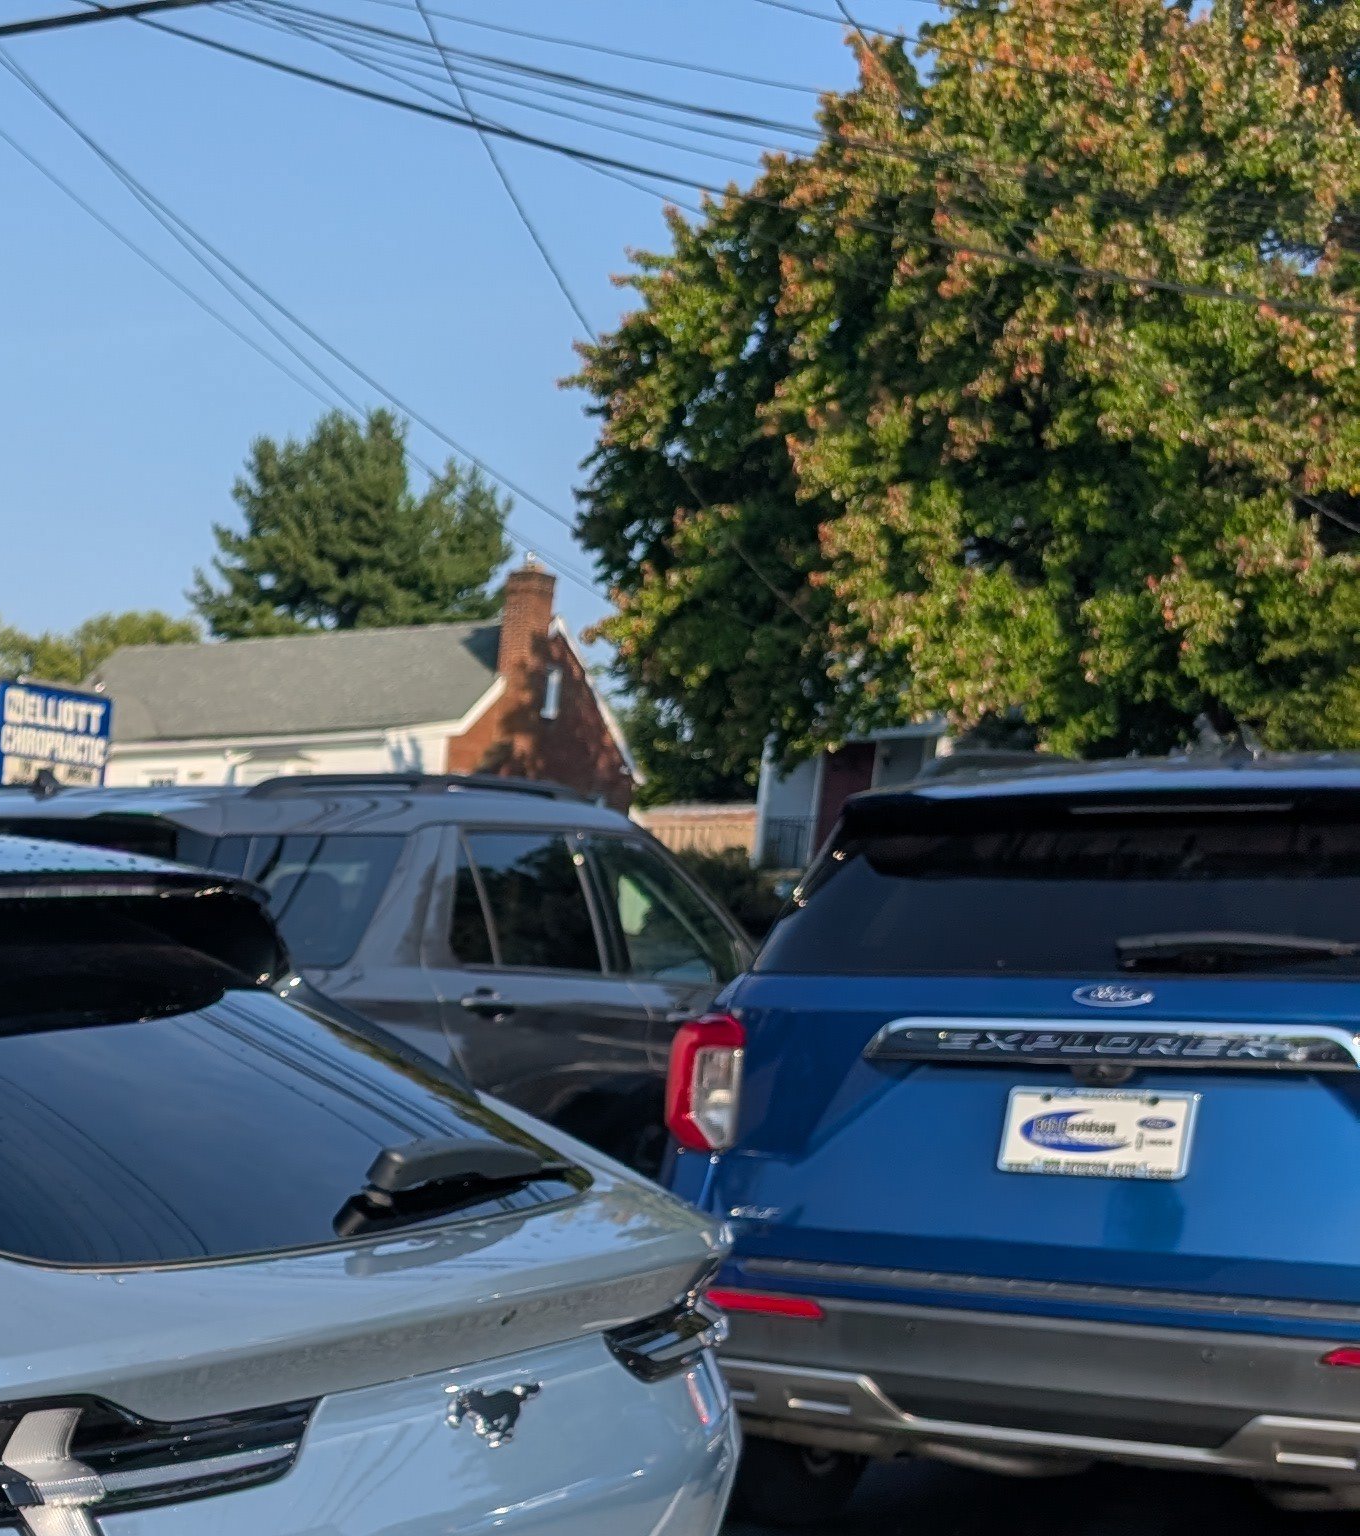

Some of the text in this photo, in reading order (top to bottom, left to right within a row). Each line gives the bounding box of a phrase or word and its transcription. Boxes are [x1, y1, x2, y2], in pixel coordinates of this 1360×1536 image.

[0, 724, 107, 767] CHIROPRACTIC
[938, 1031, 1268, 1058] EXPLORER
[1059, 1117, 1116, 1135] Davidson
